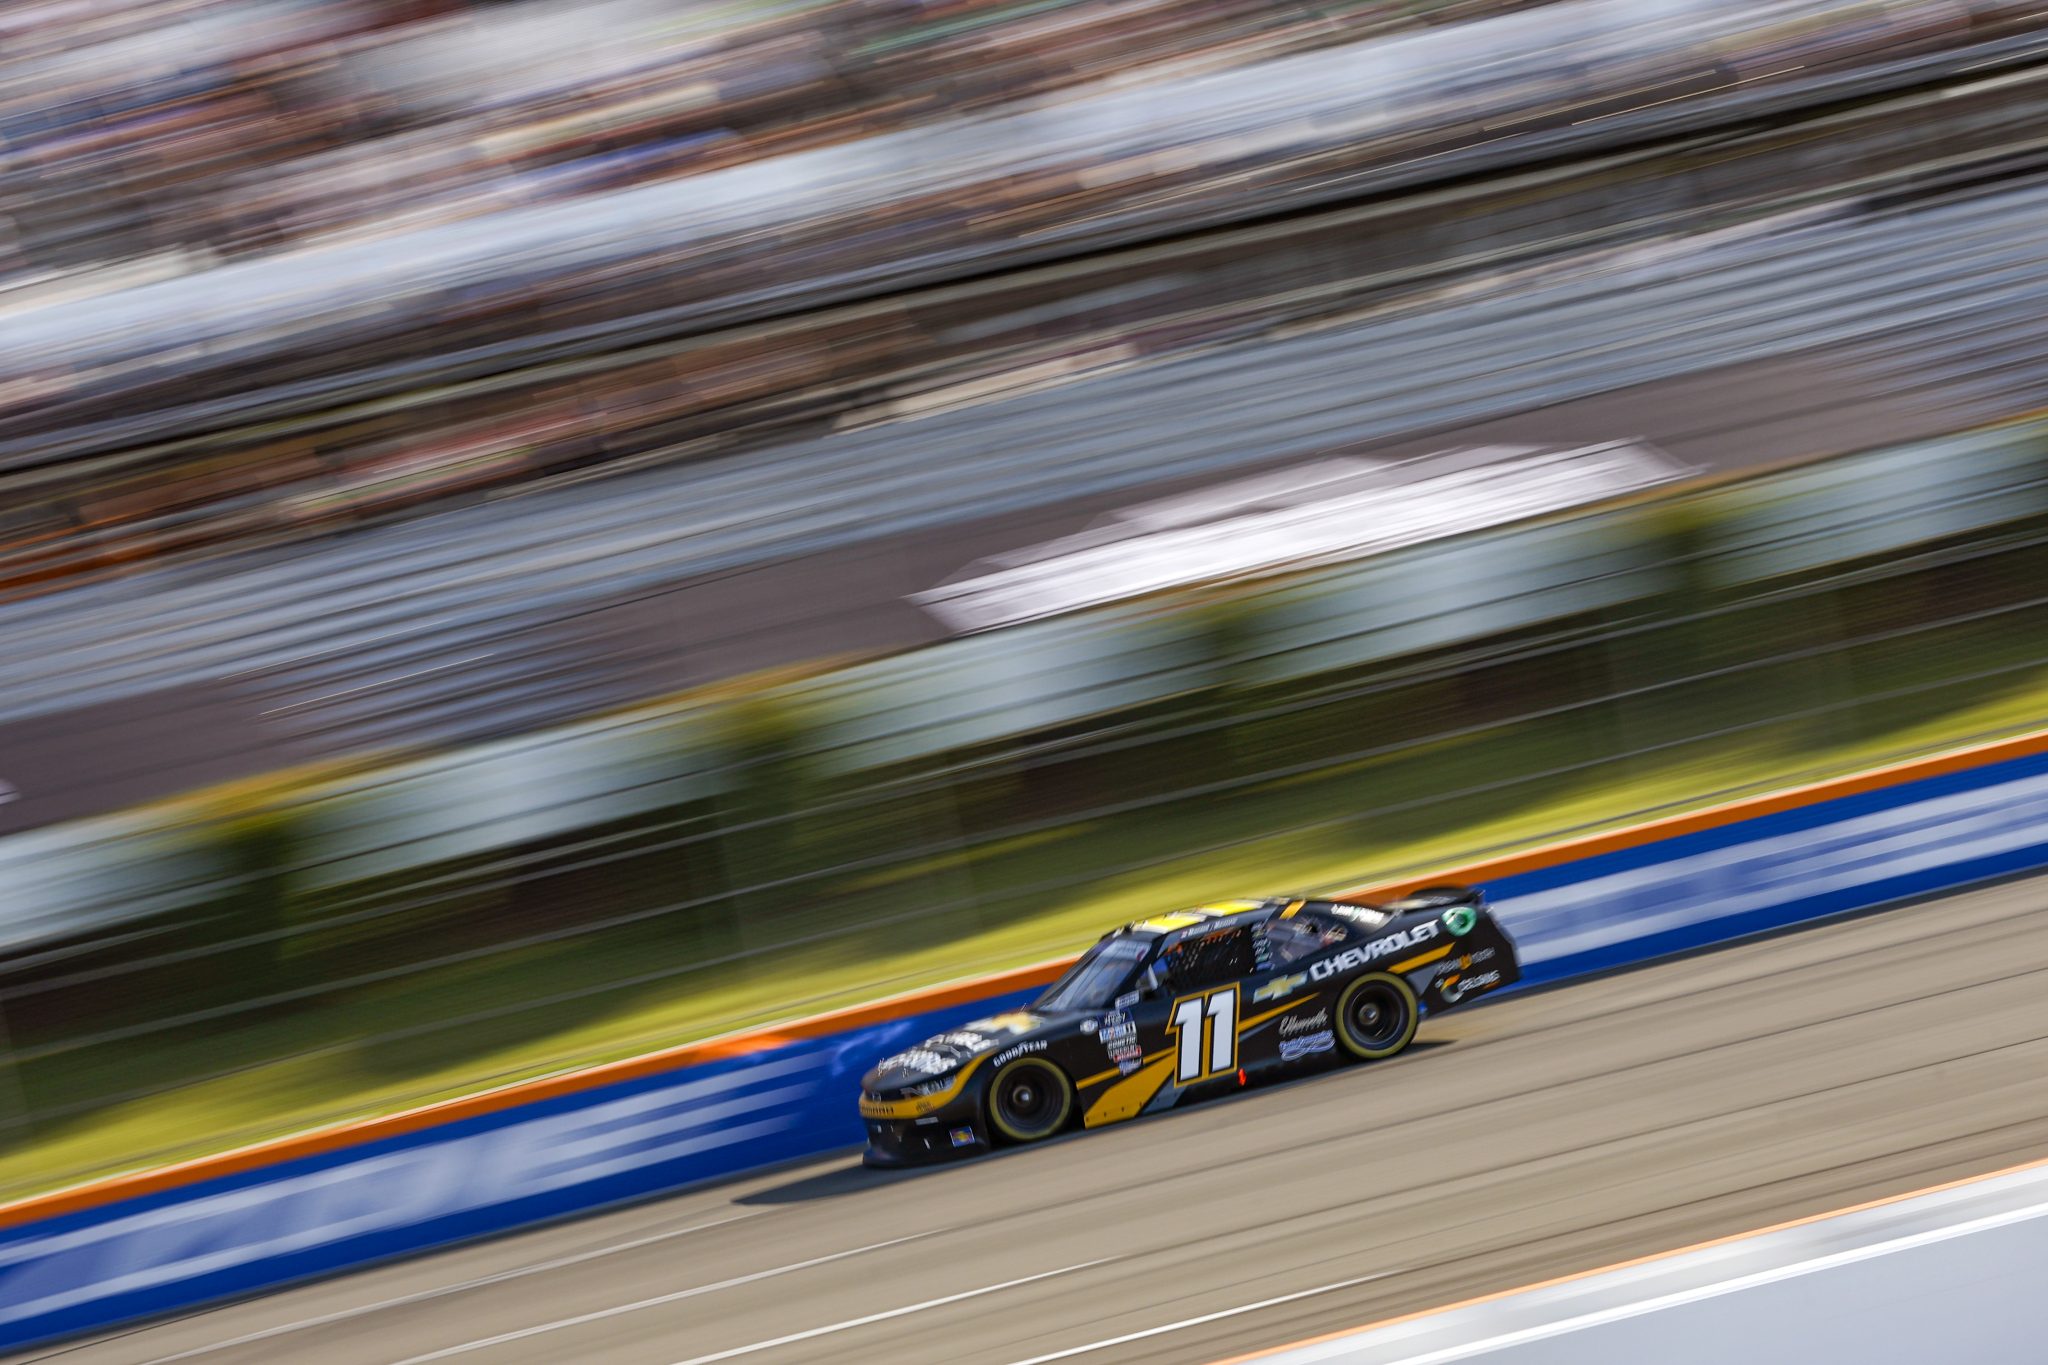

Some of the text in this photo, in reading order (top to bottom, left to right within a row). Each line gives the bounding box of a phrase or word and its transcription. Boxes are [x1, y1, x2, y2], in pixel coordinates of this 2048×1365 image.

[1309, 919, 1440, 981] CHEVROLET
[993, 1040, 1048, 1067] GOODYEAR
[1172, 986, 1236, 1083] 11
